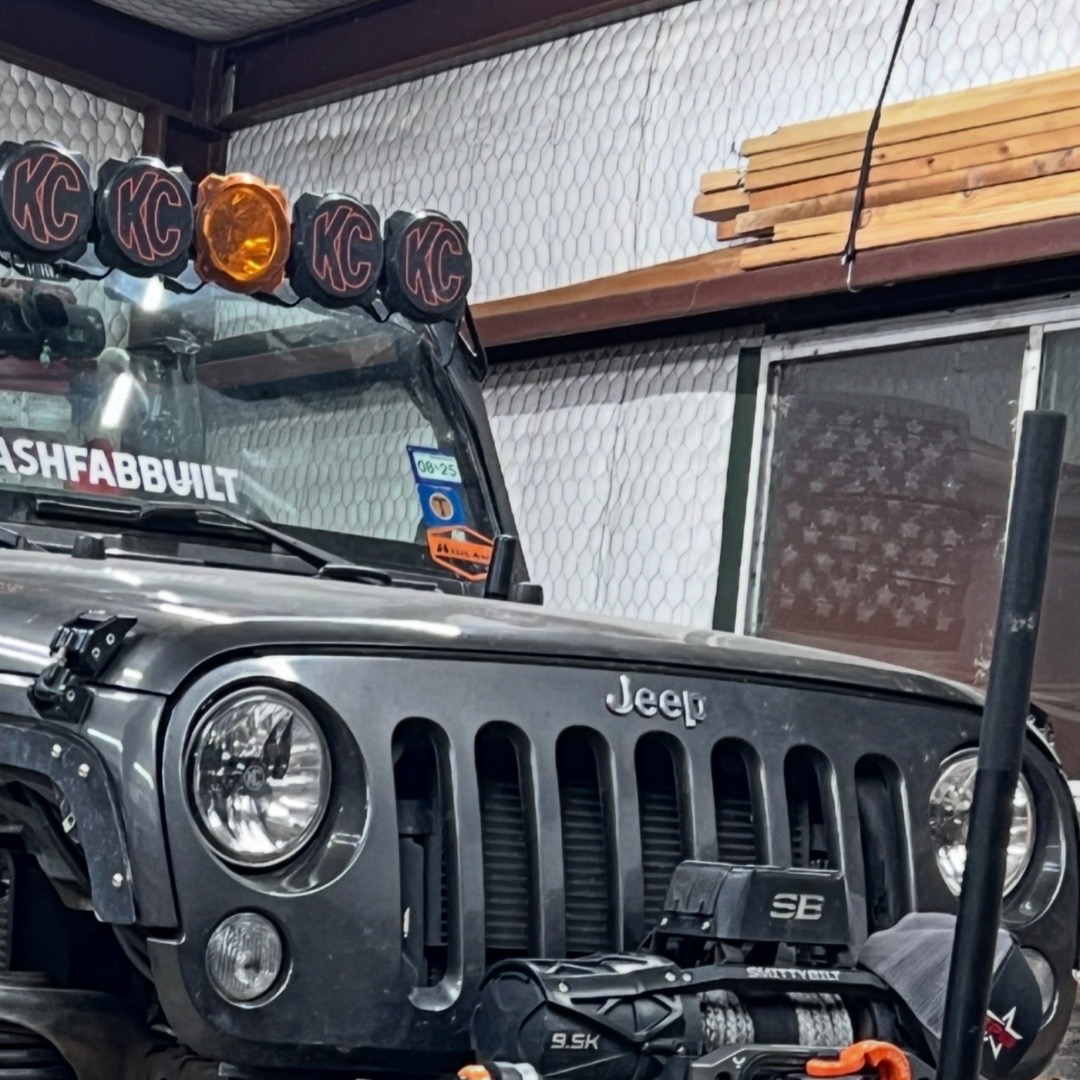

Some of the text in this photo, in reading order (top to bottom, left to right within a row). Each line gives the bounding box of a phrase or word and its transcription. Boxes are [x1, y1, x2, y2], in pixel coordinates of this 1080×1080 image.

[12, 153, 81, 244] KC
[117, 170, 182, 261] KC
[312, 204, 373, 293] KC
[405, 221, 464, 306] KC
[606, 674, 707, 727] Jeep
[550, 1033, 600, 1050] 9.5K
